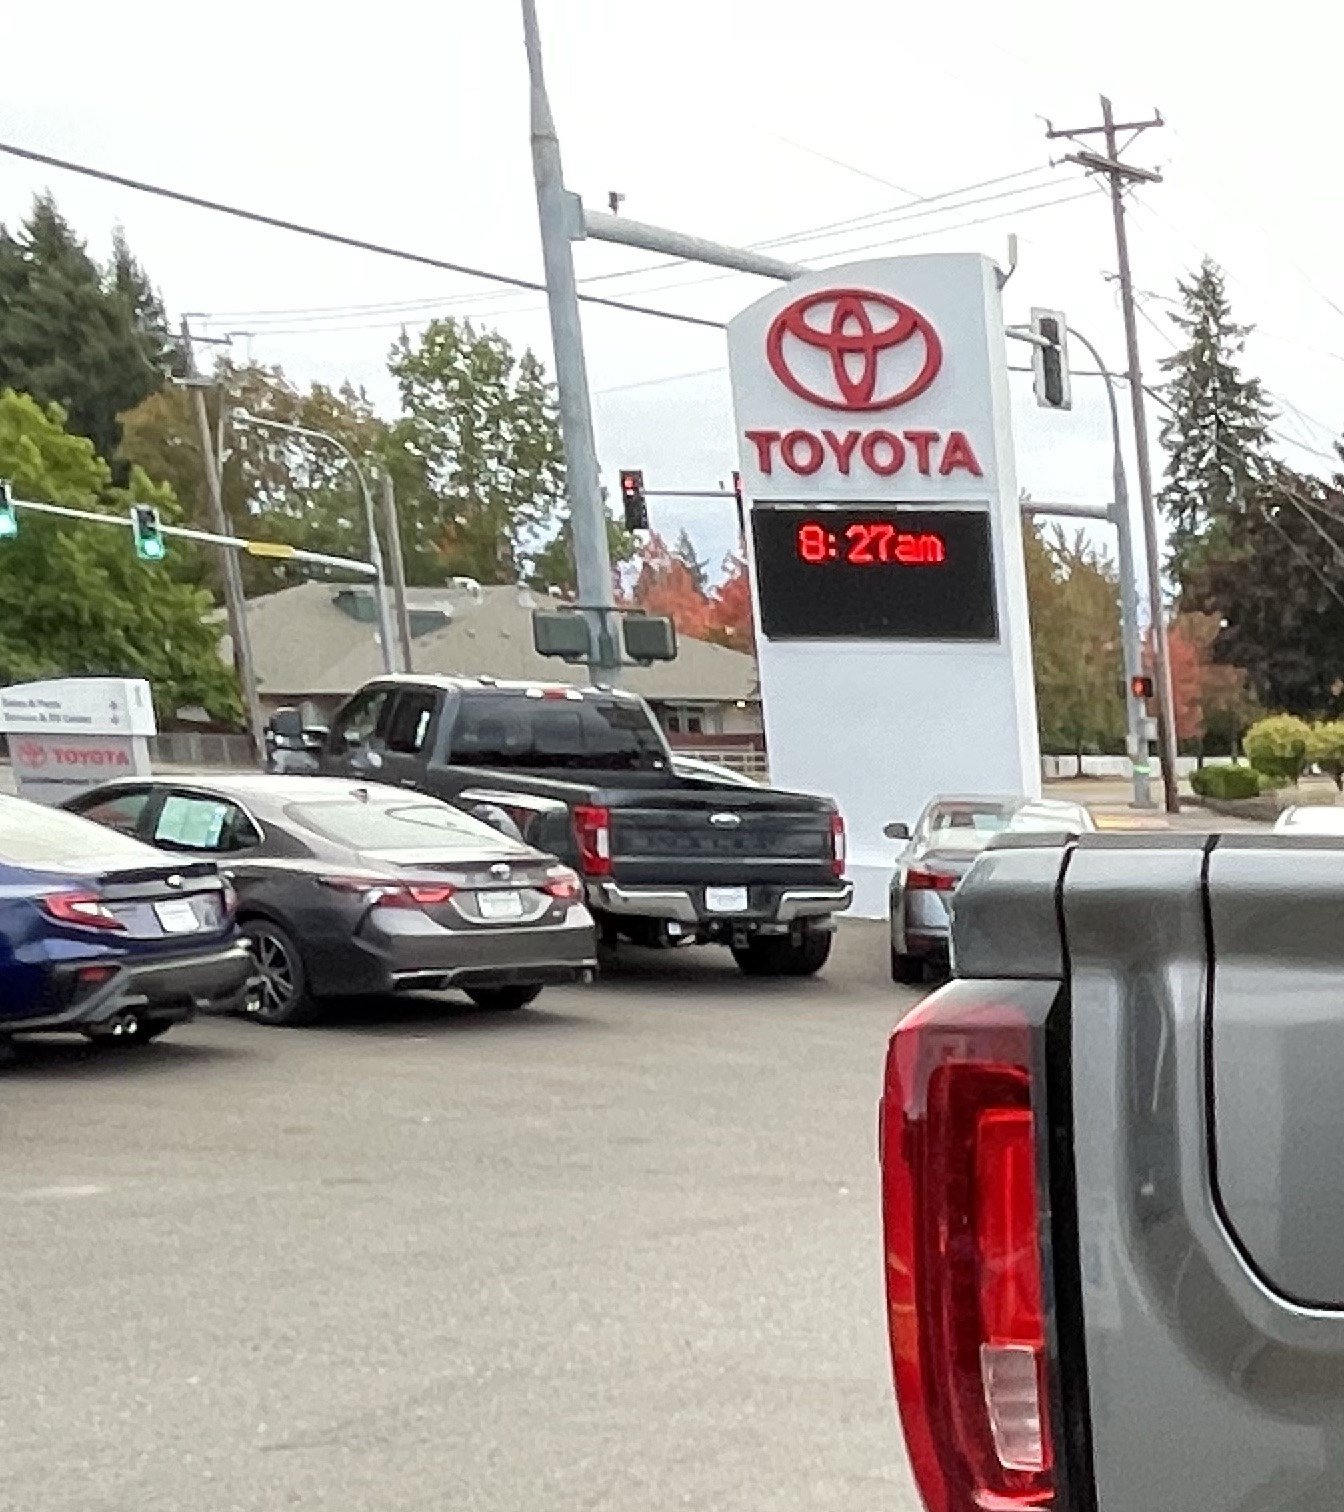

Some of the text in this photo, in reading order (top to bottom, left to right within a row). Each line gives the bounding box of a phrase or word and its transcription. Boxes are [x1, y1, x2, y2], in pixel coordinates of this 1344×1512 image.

[744, 430, 983, 477] TOYOTA
[798, 522, 945, 564] 8:27am
[52, 748, 130, 766] TOYOTA
